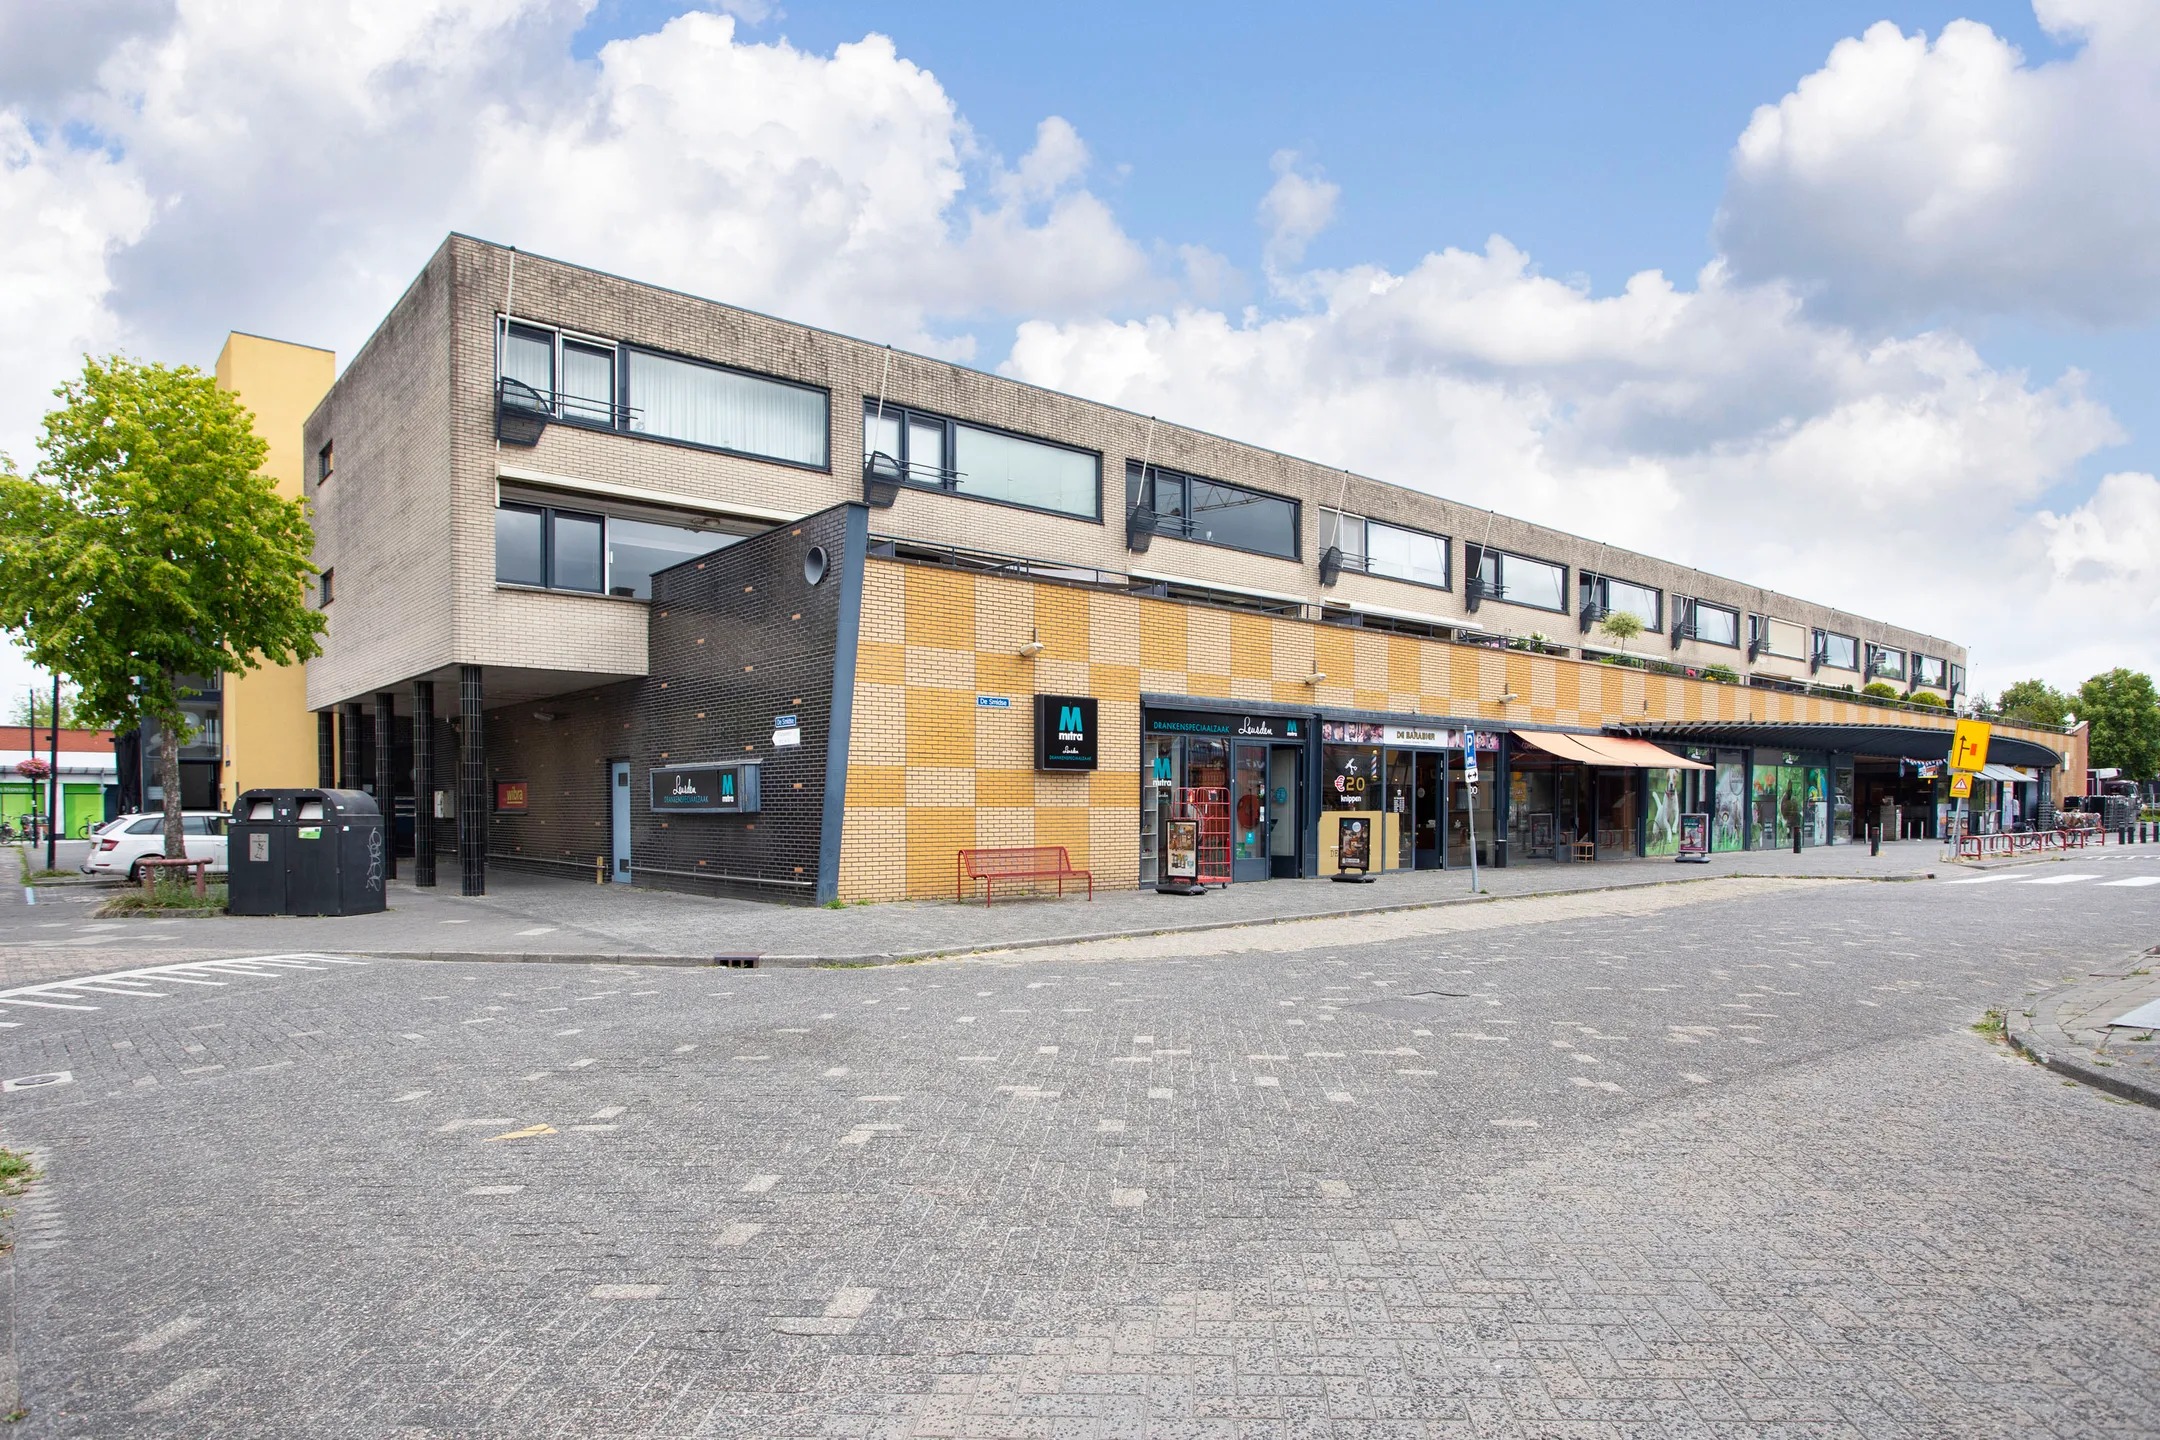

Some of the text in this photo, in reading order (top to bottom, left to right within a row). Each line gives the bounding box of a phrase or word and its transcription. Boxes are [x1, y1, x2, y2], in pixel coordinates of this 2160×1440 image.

[979, 697, 1007, 706] De Smidse
[1153, 716, 1273, 735] DRANKENSPECIAALZAAK Leusden
[1058, 731, 1084, 741] mitra
[1467, 735, 1473, 752] P
[673, 775, 697, 795] Leusden
[1152, 778, 1172, 787] mitra
[1340, 794, 1362, 804] knippen
